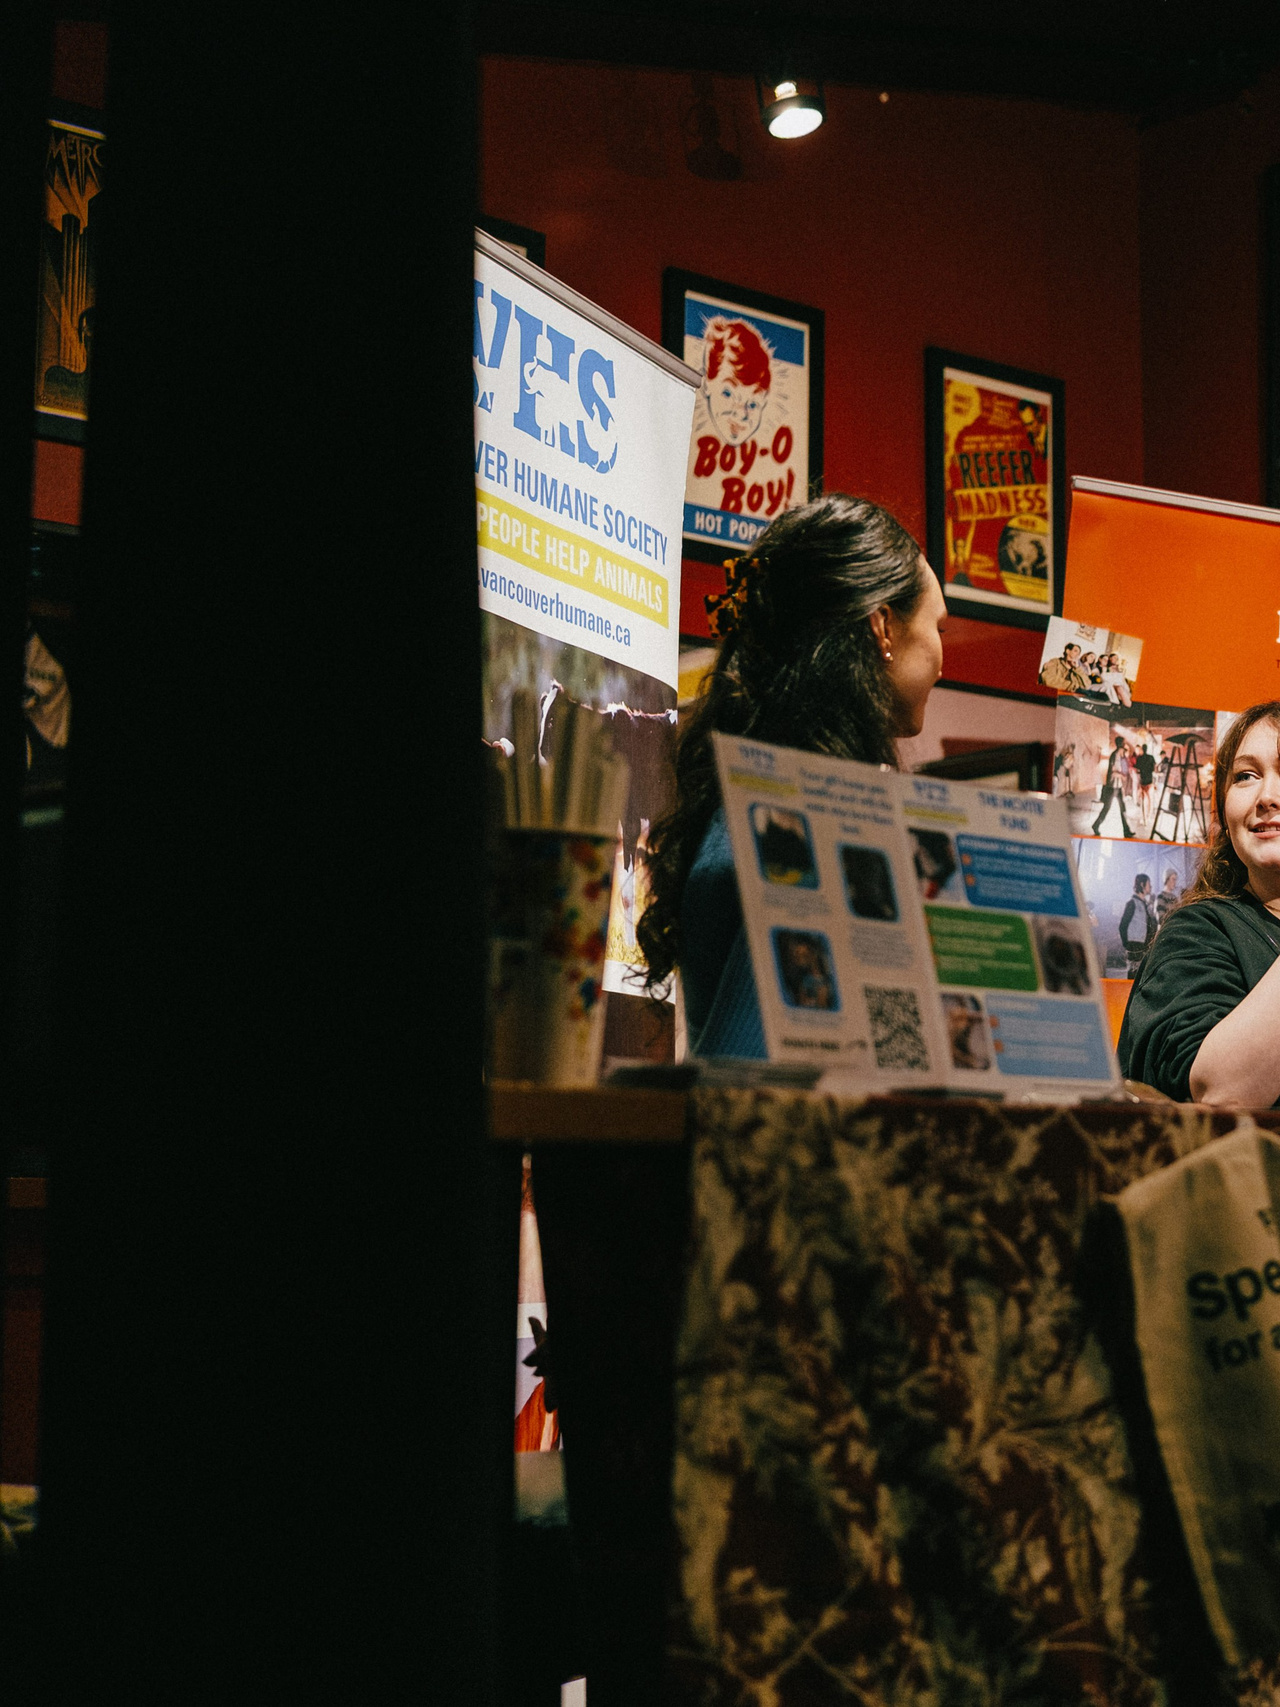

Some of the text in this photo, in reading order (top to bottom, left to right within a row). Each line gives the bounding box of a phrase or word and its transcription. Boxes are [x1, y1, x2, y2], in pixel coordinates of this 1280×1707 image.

[958, 451, 1037, 490] REEFER
[514, 458, 599, 531] HUMANE
[603, 503, 668, 565] SOCIETY
[694, 511, 722, 534] HOT
[956, 489, 1047, 520] MADNESS
[476, 501, 663, 613] PEOPLE HELP ANIMALS
